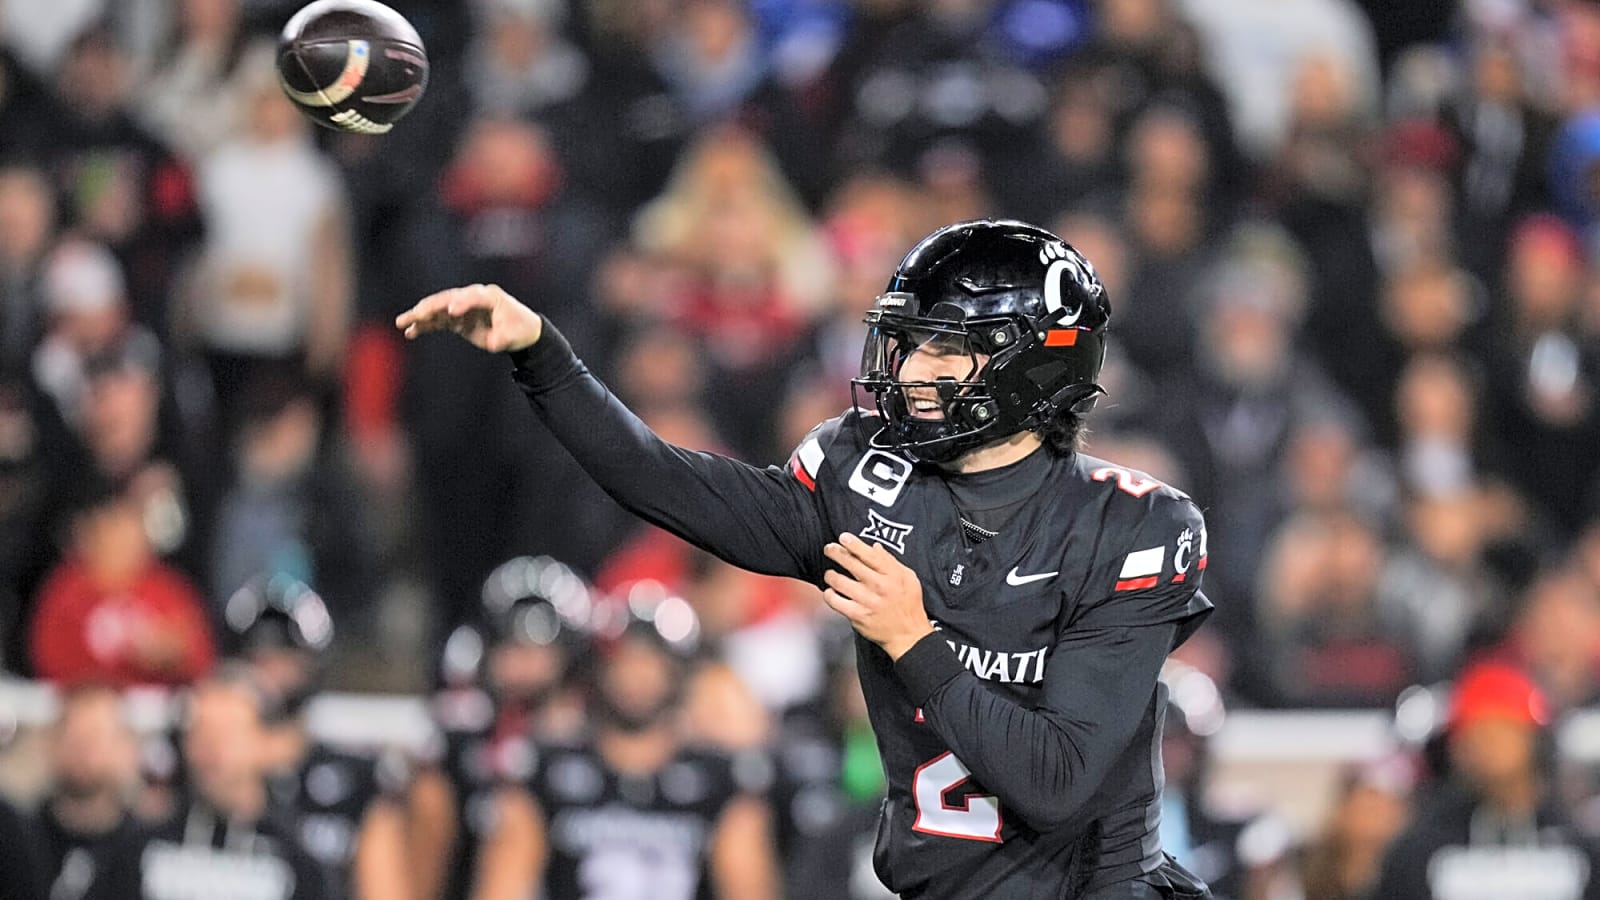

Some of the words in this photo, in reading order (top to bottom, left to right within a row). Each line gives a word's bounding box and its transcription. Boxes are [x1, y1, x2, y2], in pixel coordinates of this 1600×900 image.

[1044, 258, 1083, 326] C
[861, 453, 906, 491] C
[1091, 467, 1162, 498] 2
[863, 512, 911, 552] XII
[1174, 538, 1192, 574] C
[912, 749, 1003, 843] 2
